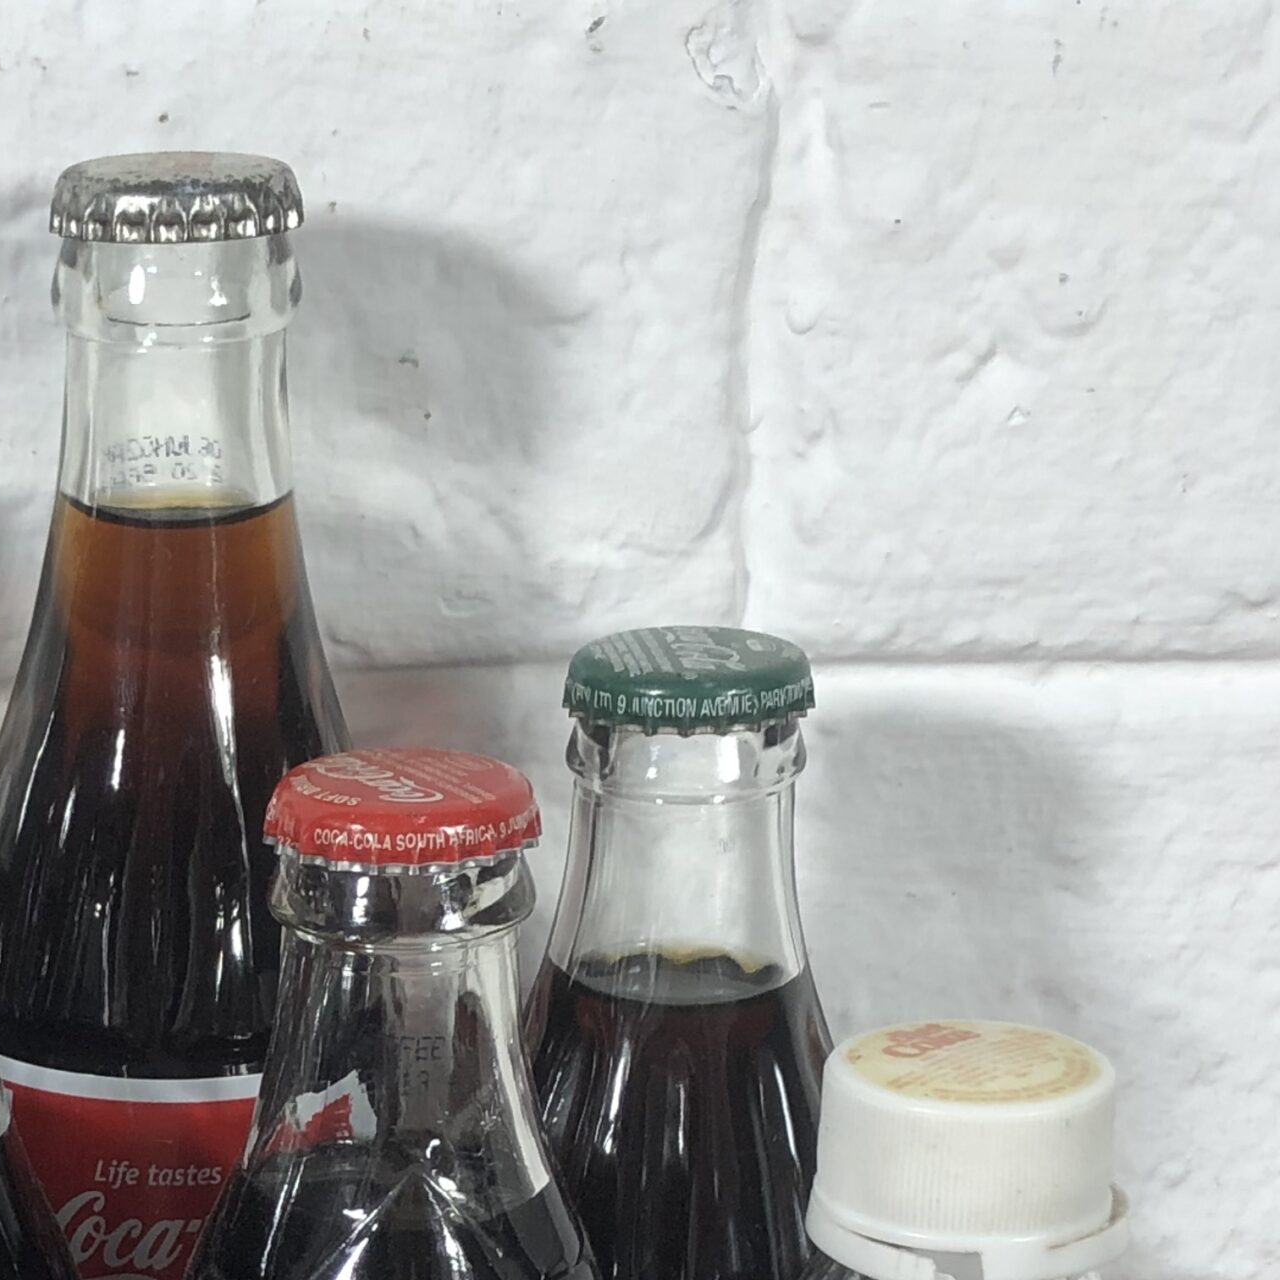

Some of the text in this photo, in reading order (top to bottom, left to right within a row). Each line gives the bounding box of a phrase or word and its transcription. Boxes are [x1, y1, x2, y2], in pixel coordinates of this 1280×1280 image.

[616, 694, 627, 716] 9
[628, 696, 696, 718] JUNCTION
[312, 787, 362, 806] SOFT
[314, 827, 392, 852] COCA-COLA
[396, 829, 446, 852] SOUTH
[94, 1159, 222, 1188] Life tastes
